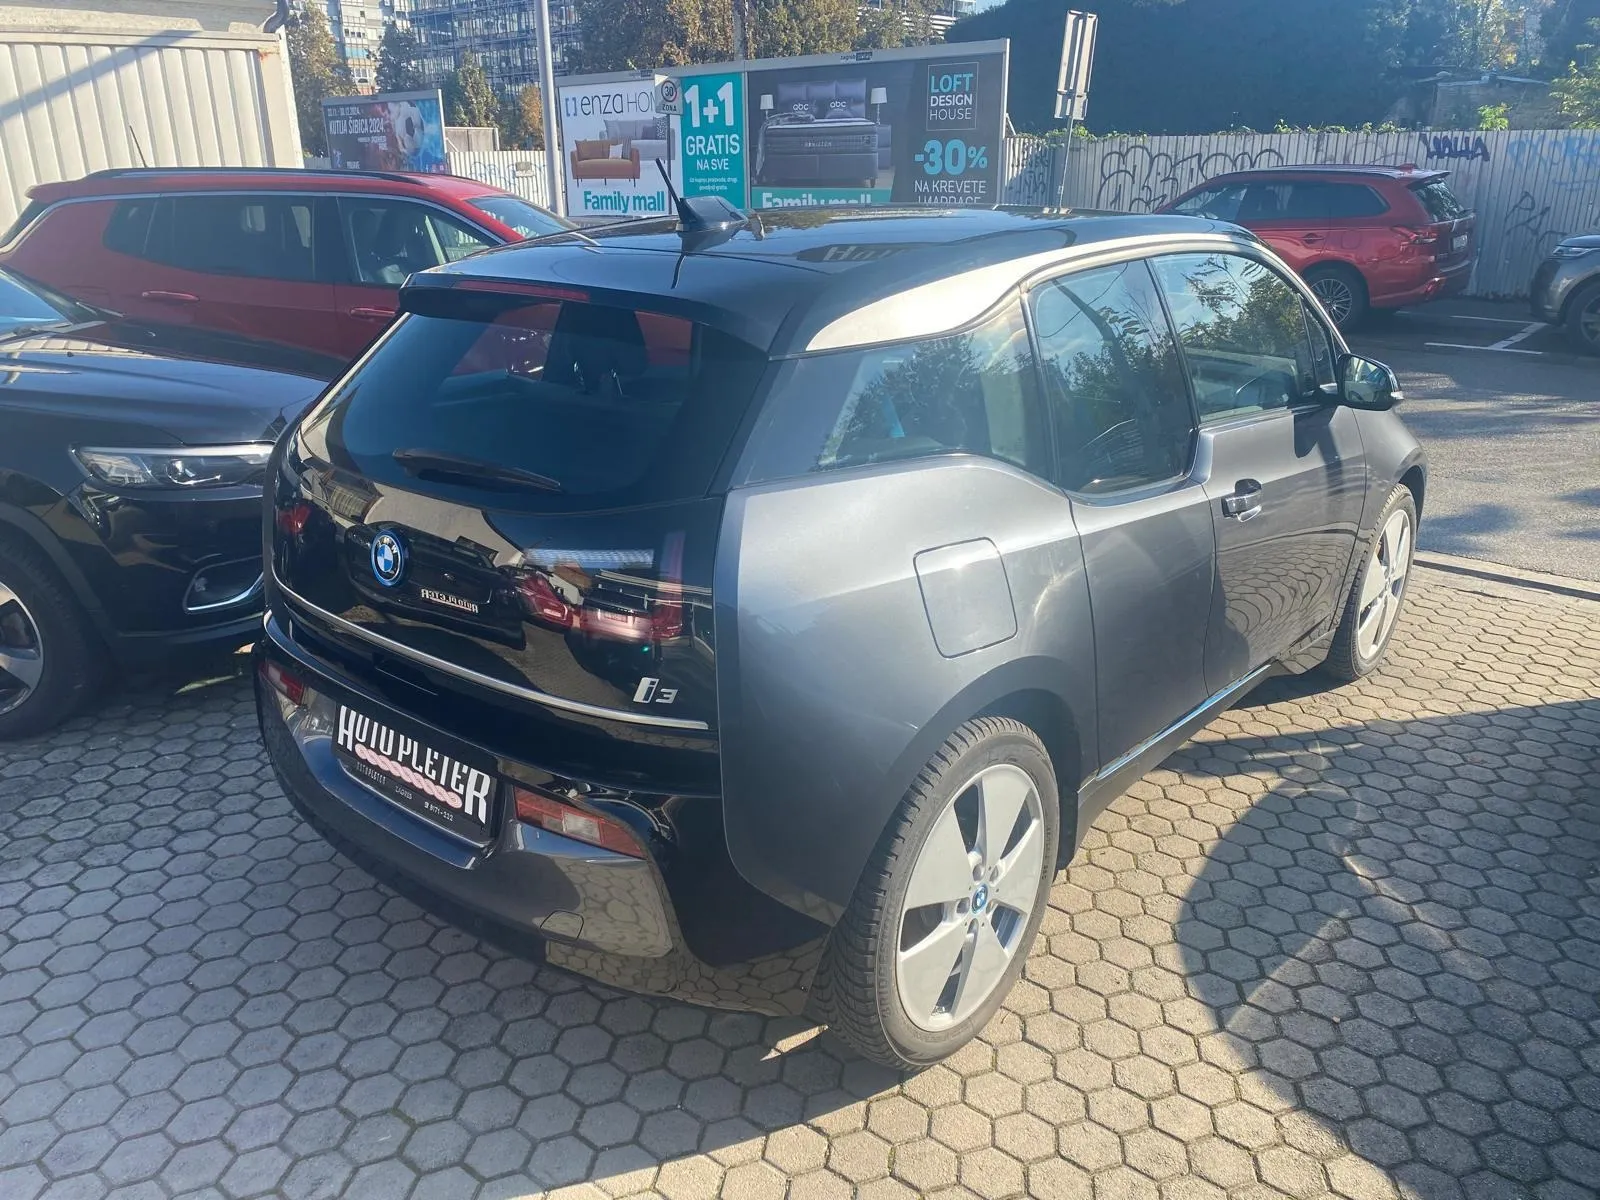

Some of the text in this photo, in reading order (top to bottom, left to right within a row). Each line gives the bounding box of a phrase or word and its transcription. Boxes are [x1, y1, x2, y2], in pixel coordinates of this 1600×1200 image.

[930, 73, 974, 93] LOFT
[664, 86, 674, 97] 30
[580, 91, 656, 116] enza HO
[662, 103, 677, 112] ZONA
[684, 81, 734, 128] 1+1
[793, 102, 809, 111] abc
[830, 100, 847, 109] abc
[930, 94, 973, 107] DESIGN
[929, 107, 973, 121] HOUSE
[329, 120, 348, 135] KUTIJA
[348, 116, 369, 135] ŠIBICA
[685, 134, 740, 156] GRATIS
[696, 158, 729, 171] NA SVE
[914, 139, 988, 176] -30%
[914, 180, 987, 194] NA KREVETE
[583, 190, 665, 214] Family mall
[633, 677, 678, 704] i3
